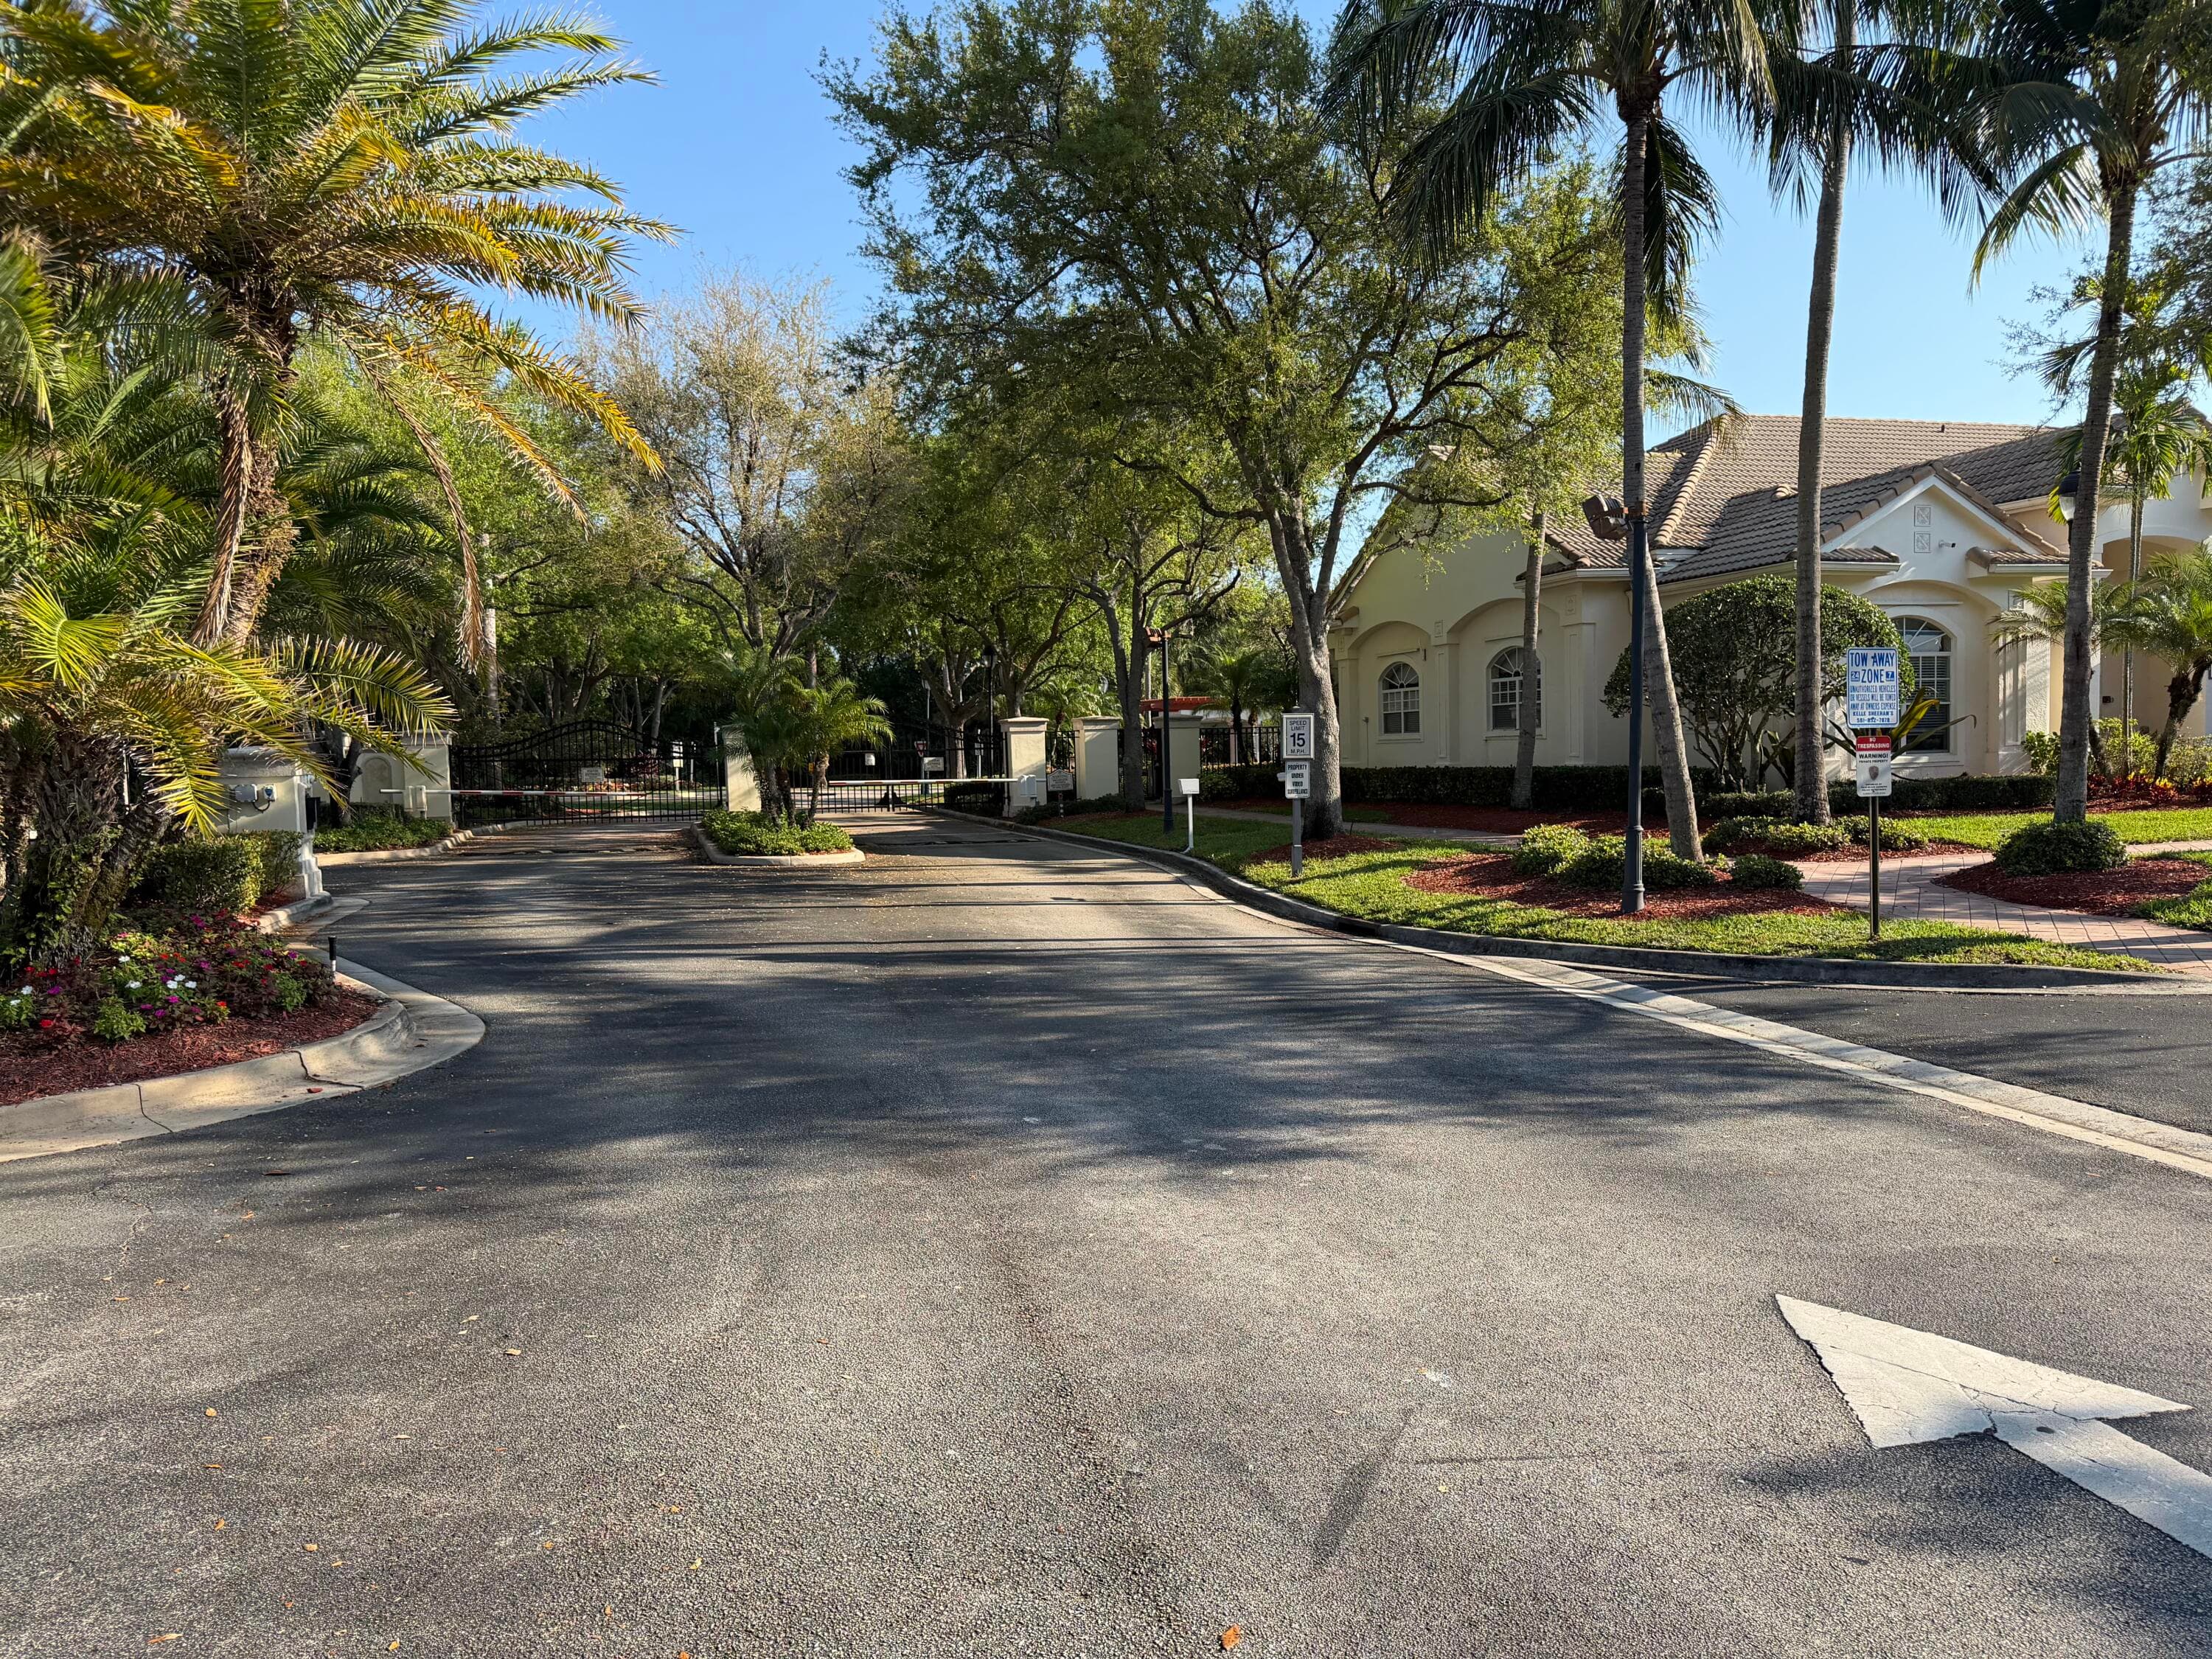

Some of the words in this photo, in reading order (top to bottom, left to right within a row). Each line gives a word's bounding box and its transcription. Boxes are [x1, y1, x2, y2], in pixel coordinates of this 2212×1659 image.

[1850, 652, 1868, 667] TOW
[1872, 652, 1895, 667] AWAY
[1861, 669, 1885, 684] ZONE
[1850, 685, 1877, 693] UNAUTHORIZED
[1879, 685, 1896, 693] VEHICLES
[1290, 733, 1305, 747] 15
